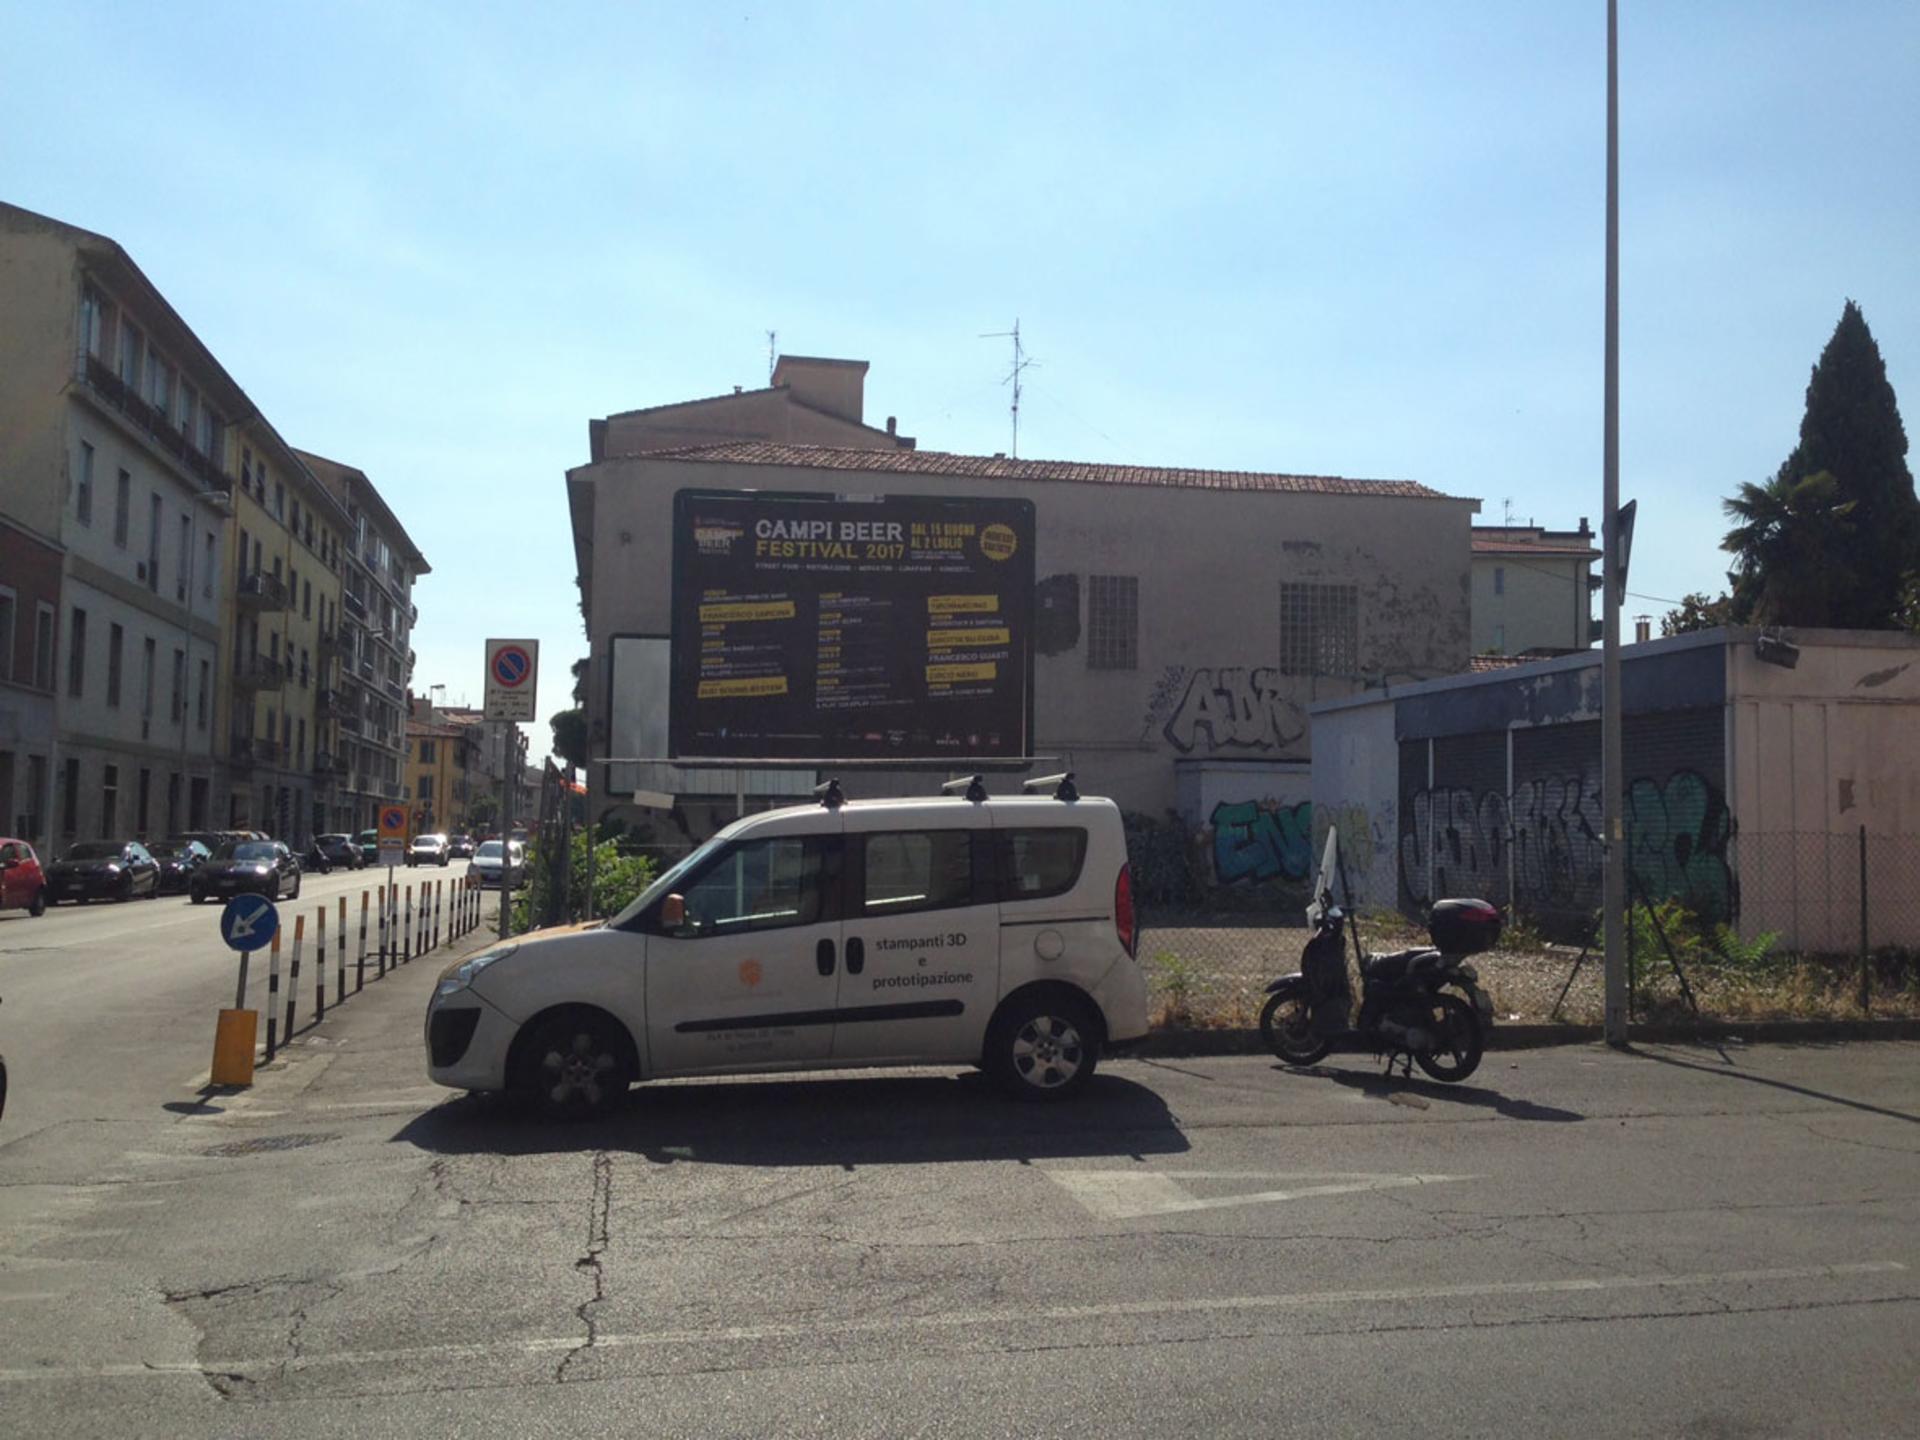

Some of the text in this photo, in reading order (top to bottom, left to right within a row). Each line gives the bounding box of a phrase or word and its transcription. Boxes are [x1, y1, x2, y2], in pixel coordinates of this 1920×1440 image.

[756, 520, 832, 540] CAMPI
[840, 521, 903, 542] BEER
[756, 540, 859, 559] FESTIVAL
[866, 544, 904, 560] 2017
[876, 933, 967, 951] stampanti 3D
[918, 957, 927, 967] e
[872, 971, 973, 990] prototipazione
